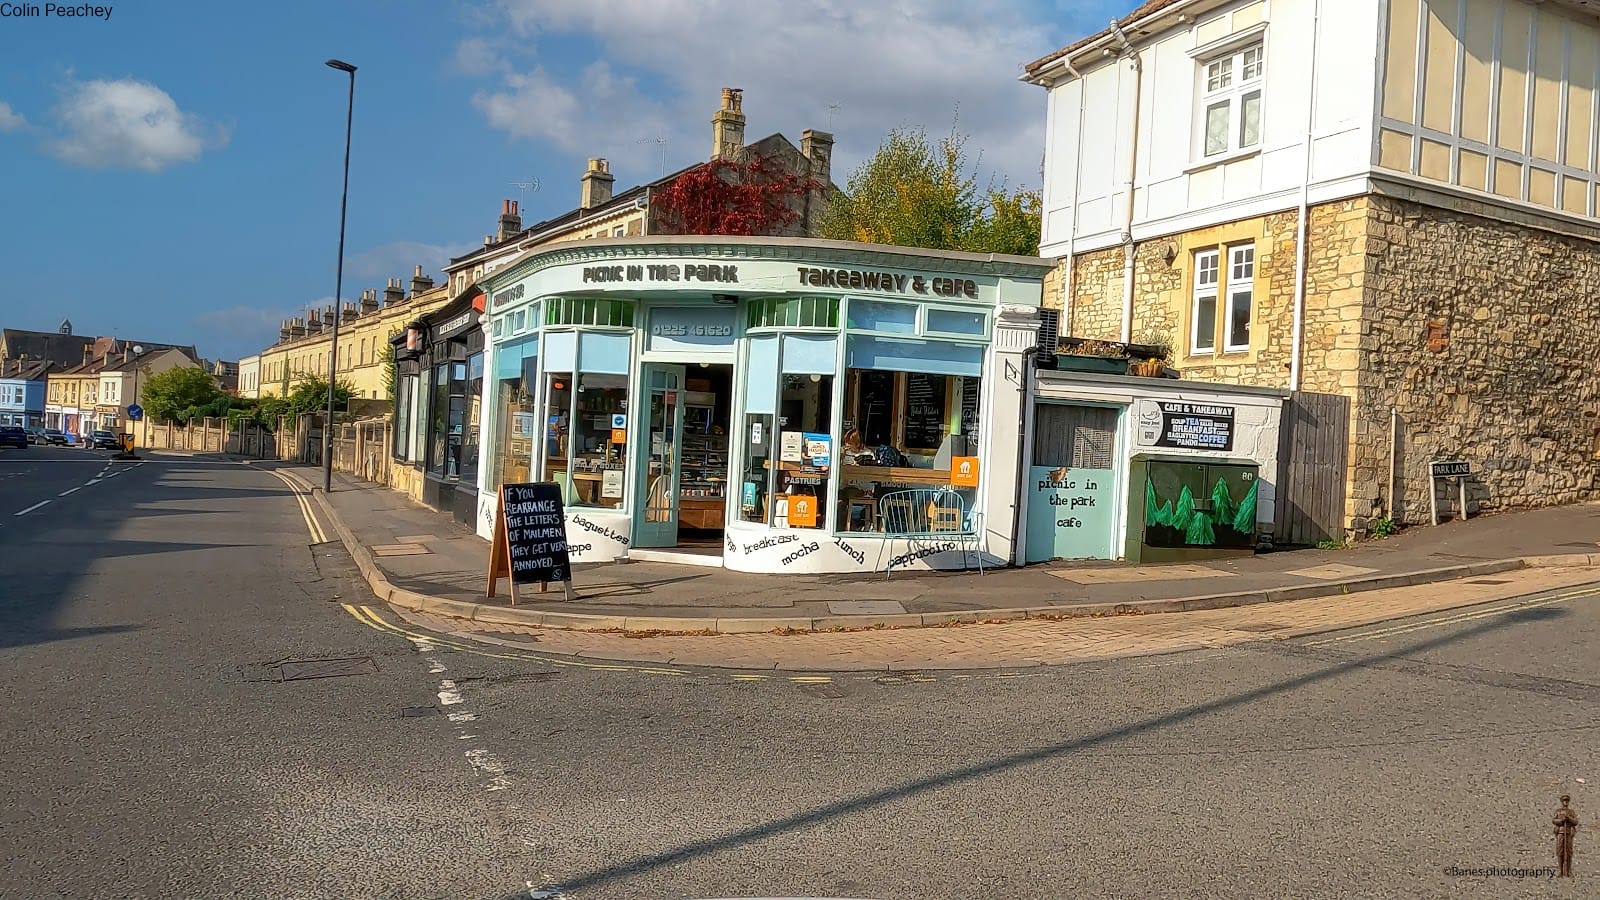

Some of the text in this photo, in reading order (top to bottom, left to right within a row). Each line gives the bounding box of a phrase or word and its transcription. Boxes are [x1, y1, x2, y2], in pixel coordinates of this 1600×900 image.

[583, 267, 624, 284] PICNIC
[626, 265, 643, 282] IN
[912, 275, 926, 294] &
[653, 324, 685, 336] 01225
[1164, 404, 1183, 412] CAFE
[1192, 405, 1233, 415] TAKEAWAY
[1185, 417, 1199, 426] TEA
[1172, 424, 1218, 435] BREAKFAST
[1199, 434, 1228, 444] COFFEE
[1434, 464, 1469, 474] PARK LANE
[1038, 478, 1098, 491] picnic in
[505, 487, 534, 501] IF YOU
[505, 500, 557, 515] REARRANGE
[1049, 494, 1096, 510] the park
[507, 515, 522, 528] THE
[524, 514, 560, 526] LETTERS
[1056, 517, 1082, 528] cafe
[509, 530, 521, 542] OF
[572, 514, 630, 545] baguettes
[511, 544, 530, 558] THEY
[532, 542, 547, 555] GET
[742, 533, 801, 555] breakfast
[833, 536, 866, 565] lunch
[781, 539, 821, 566] mocha
[886, 541, 956, 569] cappuccino
